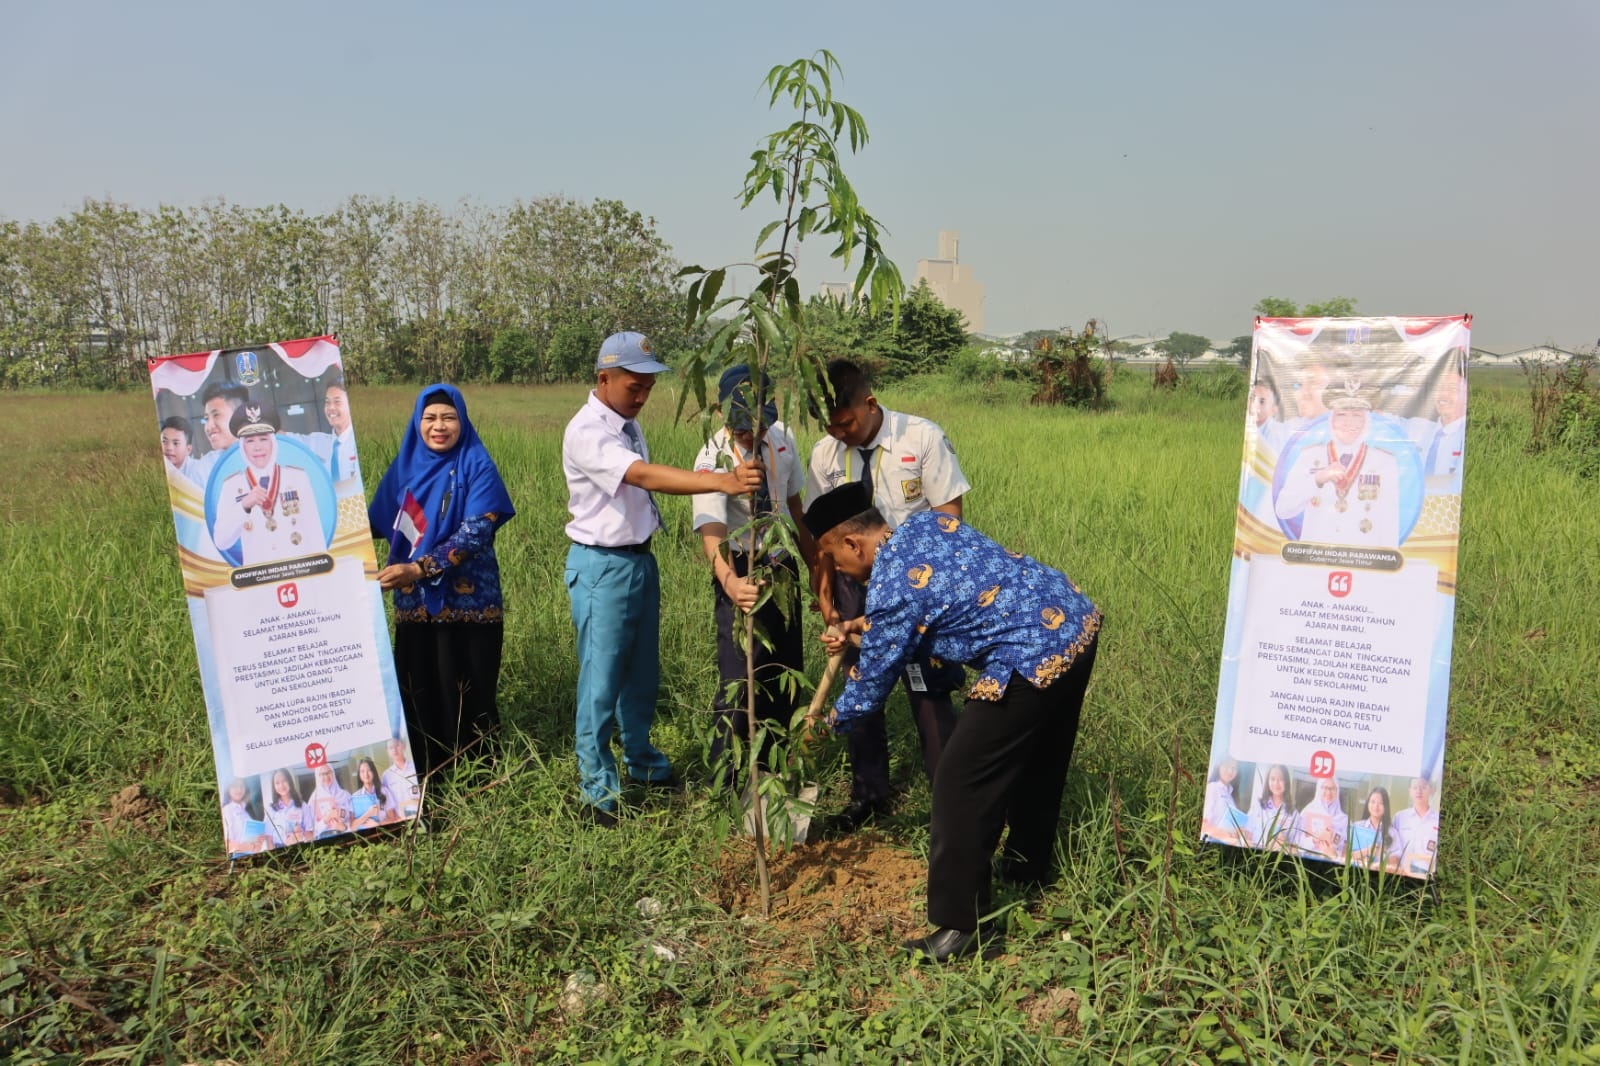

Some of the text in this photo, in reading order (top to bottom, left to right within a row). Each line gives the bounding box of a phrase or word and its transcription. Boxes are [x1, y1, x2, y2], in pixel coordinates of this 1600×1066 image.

[1287, 547, 1324, 555] KHOFIFAH
[1349, 552, 1396, 561] PARAWANSA
[234, 558, 328, 580] KHOFIFAH INDAR PARAWANSA
[1301, 600, 1324, 609] ANAK
[243, 614, 341, 637] SELAMAT MEMASUKI TAHUN
[260, 615, 280, 624] ANAK
[1279, 608, 1395, 626] SELAMAT MEMASUKI TAHUN
[1305, 621, 1339, 631] AJARAN
[268, 632, 297, 642] AJARAN
[1295, 636, 1372, 651] SELAMAT BELAJAR
[233, 643, 362, 673] TERUS SEMANGAT DAN TINGKATKAN
[263, 641, 328, 658] SELAMAT BELAJAR
[1259, 642, 1411, 666] TERUS SEMANGAT DAN TINGKATKAN
[283, 662, 313, 673] JADILAH
[315, 652, 363, 666] KEBANGGAAN
[1312, 659, 1348, 669] JADILAH
[1350, 663, 1411, 676] KEBANGGAAN
[255, 665, 348, 688] UNTUK KEDUA ORANG TUA
[1276, 665, 1388, 684] UNTUK KEDUA ORANG TUA
[1293, 677, 1311, 686] DAN
[271, 686, 287, 694] DAN
[255, 688, 356, 713] JANGAN LUPA RAJIN IBADAH
[1269, 691, 1390, 712] JANGAN LUPA RAJIN IBADAH
[264, 699, 351, 721] DAN MOHON DOA RESTU
[1277, 702, 1382, 722] DAN MOHON DOA RESTU
[273, 718, 302, 728] KEPADA
[303, 713, 329, 723] ORANG
[1284, 714, 1318, 725] KEPADA
[1320, 718, 1351, 729] ORANG
[246, 740, 273, 750] SELALU
[274, 732, 313, 745] SEMANGAT
[315, 724, 355, 736] MENUNTUT
[1249, 726, 1279, 737] SELALU
[1281, 730, 1327, 743] SEMANGAT
[1329, 737, 1378, 751] MENUNTUT
